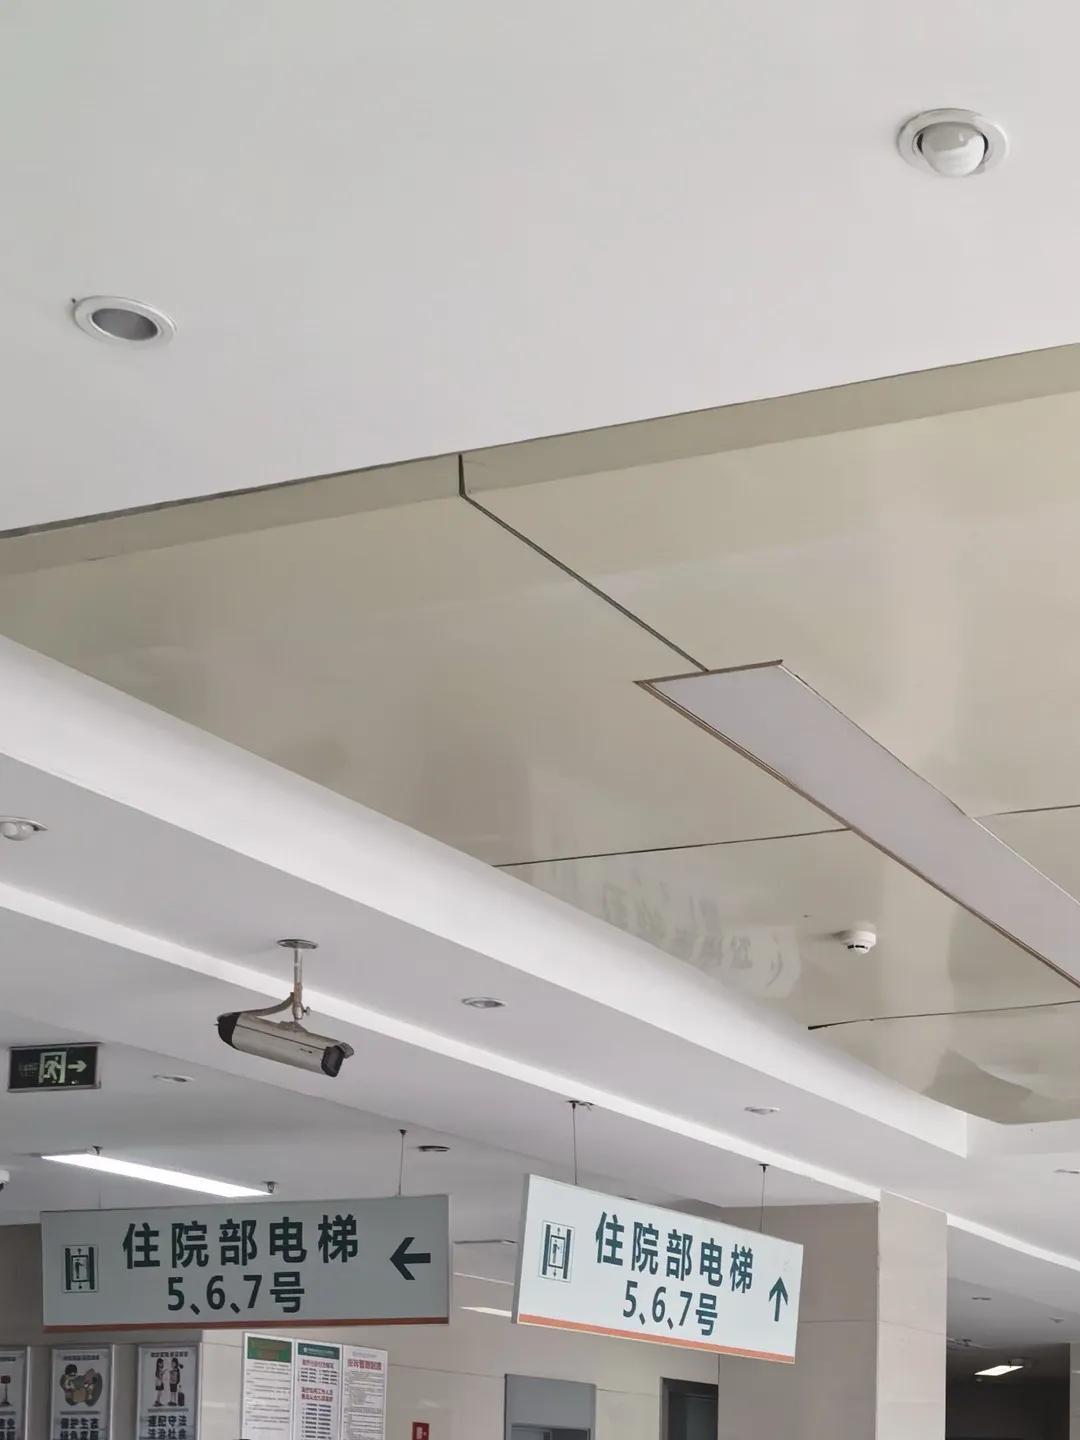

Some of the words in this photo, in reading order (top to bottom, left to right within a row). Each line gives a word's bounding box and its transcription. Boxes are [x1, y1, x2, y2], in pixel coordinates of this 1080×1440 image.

[122, 1214, 359, 1269] 住院部电梯
[595, 1211, 754, 1294] 住院部电梯
[167, 1271, 305, 1314] 5、6、7号
[623, 1280, 718, 1336] 5、6、7号
